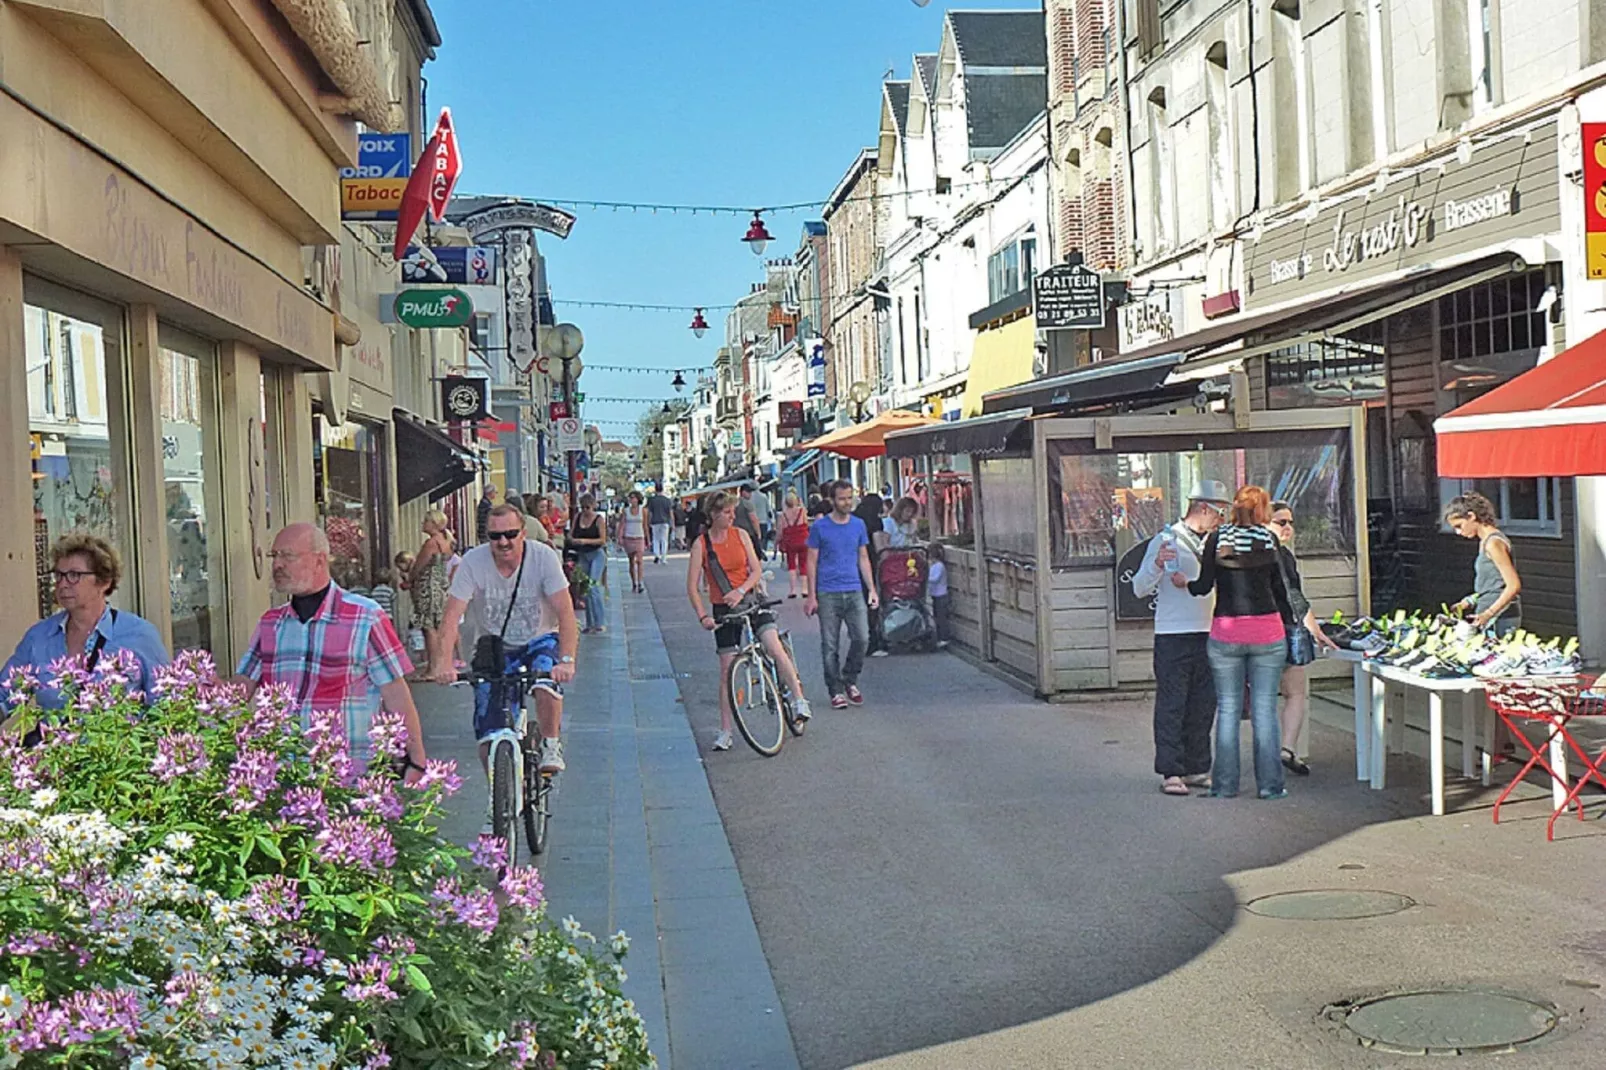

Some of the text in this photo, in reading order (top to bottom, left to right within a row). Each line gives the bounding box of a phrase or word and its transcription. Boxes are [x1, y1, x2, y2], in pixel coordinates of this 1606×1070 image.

[339, 165, 382, 178] ORD
[433, 128, 450, 201] TABAC
[345, 184, 401, 201] Tabac
[1444, 184, 1511, 232] Brasserie
[1322, 208, 1356, 270] Le
[1270, 250, 1312, 284] Brasseie
[1036, 275, 1099, 289] TRAITEUR
[401, 301, 439, 317] PMU
